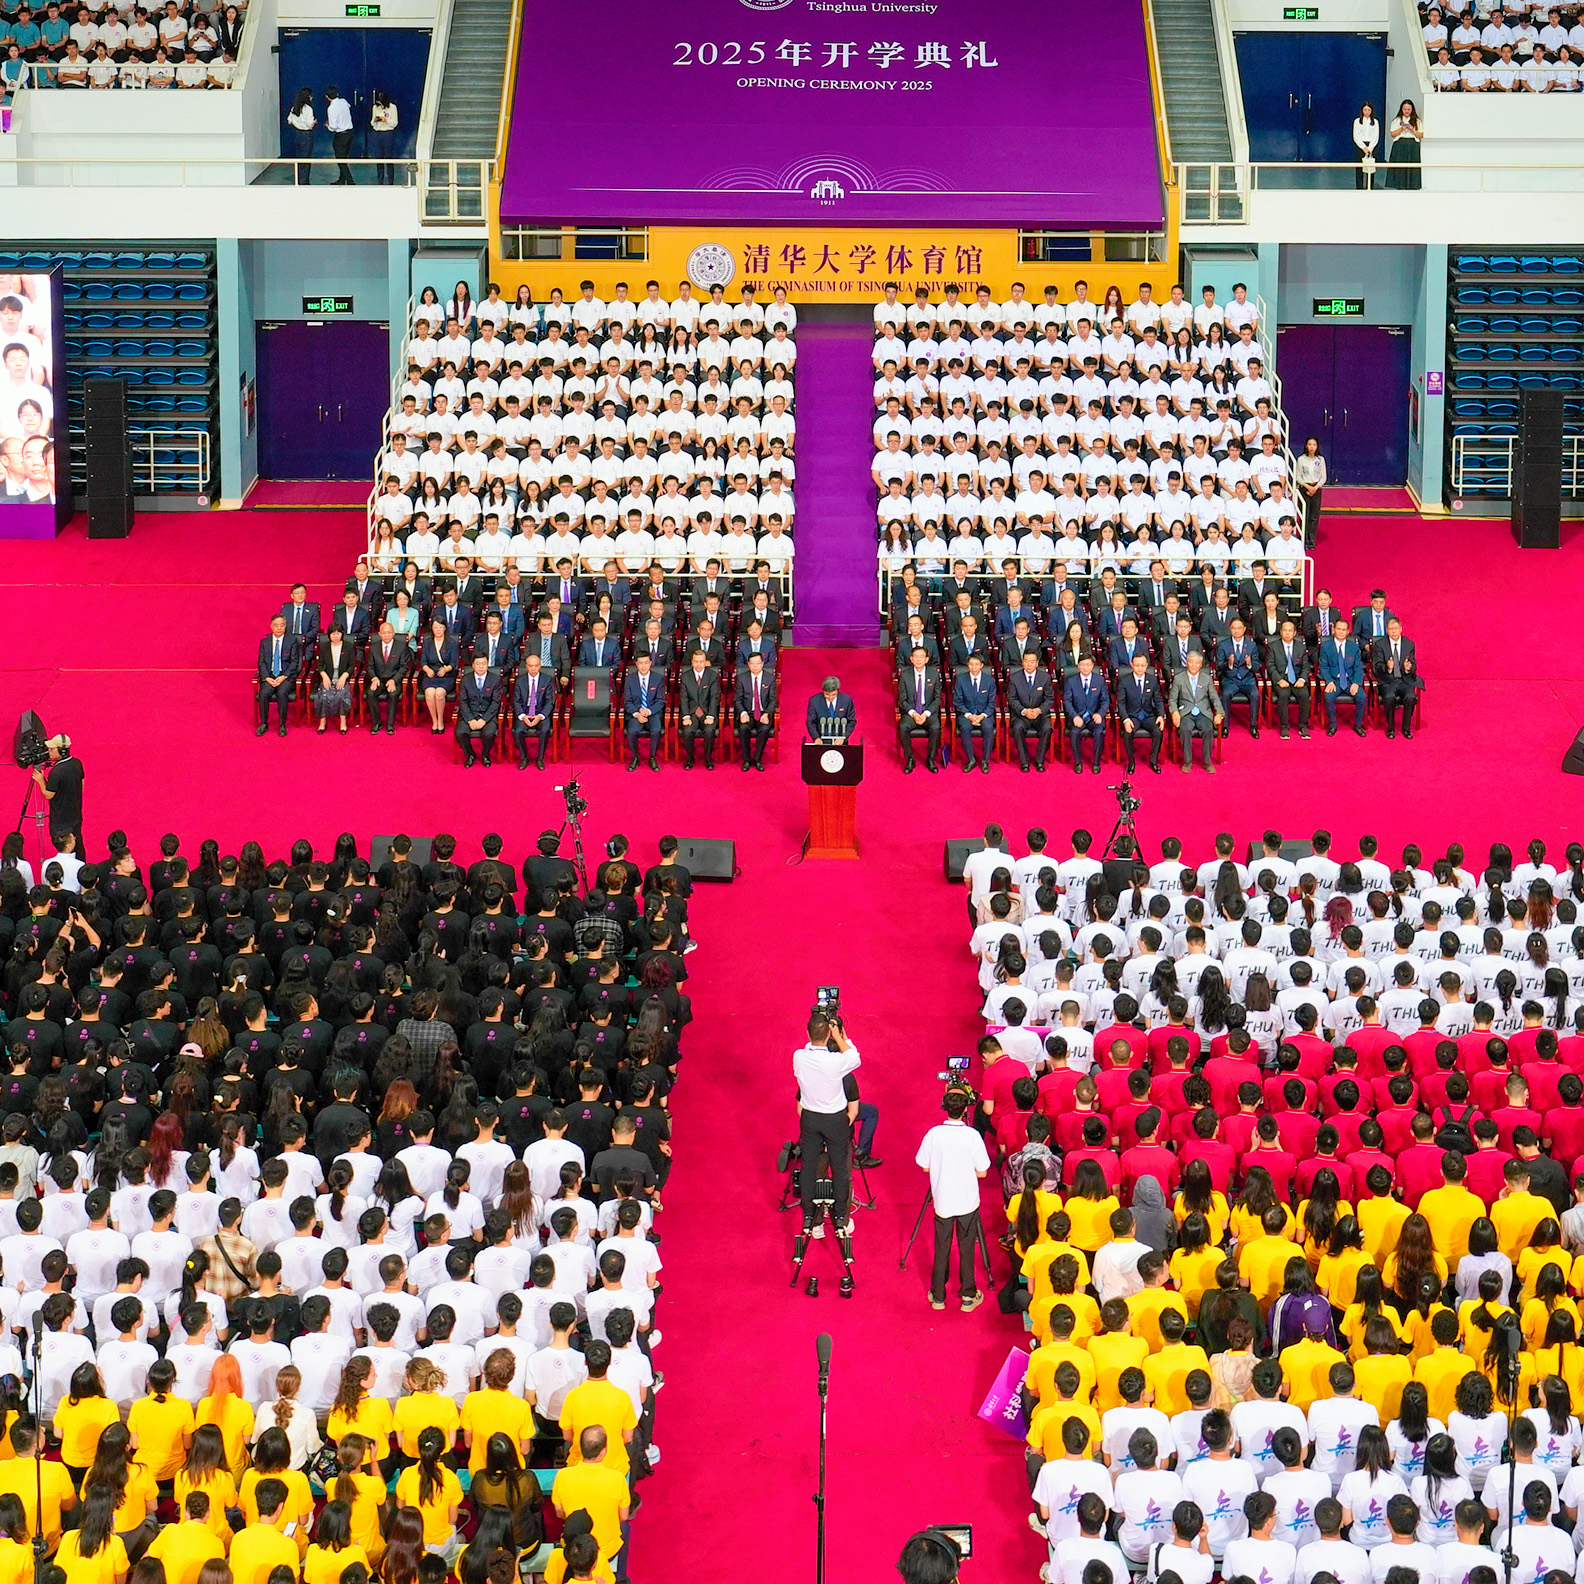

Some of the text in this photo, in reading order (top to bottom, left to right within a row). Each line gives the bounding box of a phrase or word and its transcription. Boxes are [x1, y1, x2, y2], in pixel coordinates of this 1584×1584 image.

[807, 1, 938, 15] Tsinghua University
[673, 38, 999, 69] 2025年开学典礼
[736, 78, 933, 91] OPENING CEREMONY 2025
[743, 244, 983, 275] 清华大学体育馆
[839, 281, 854, 292] OF
[1024, 874, 1039, 883] TH
[1069, 876, 1088, 886] TH
[1226, 938, 1243, 948] TH
[1325, 938, 1343, 948] TH
[1557, 942, 1573, 953] TH
[1087, 980, 1105, 990] TH
[1526, 978, 1545, 989] TH
[1152, 1010, 1168, 1020] TH
[1494, 1018, 1524, 1030] THU
[1067, 1046, 1087, 1057] HU
